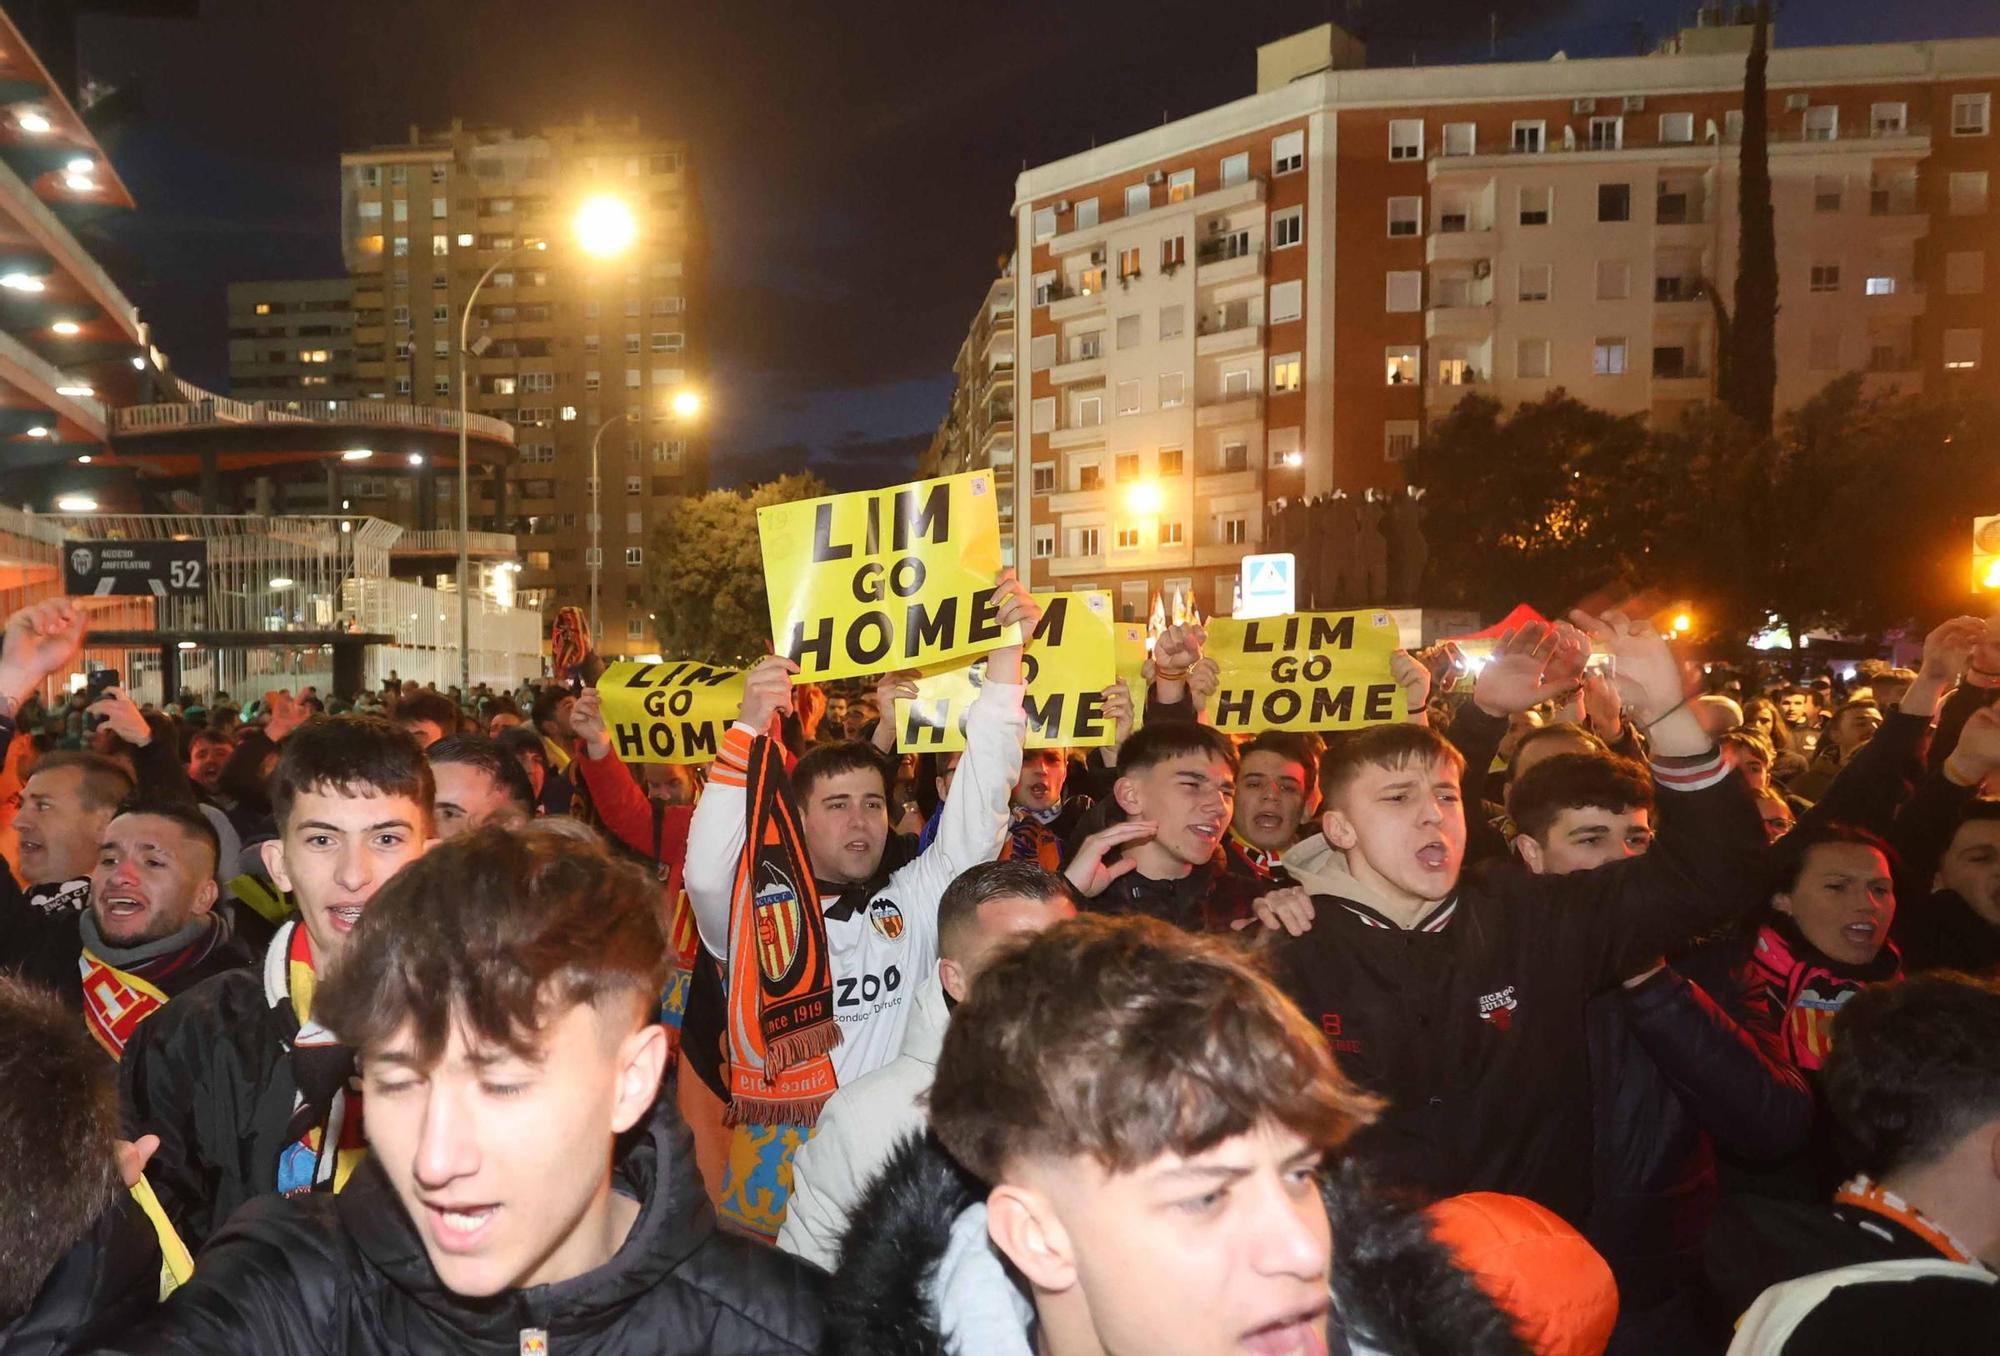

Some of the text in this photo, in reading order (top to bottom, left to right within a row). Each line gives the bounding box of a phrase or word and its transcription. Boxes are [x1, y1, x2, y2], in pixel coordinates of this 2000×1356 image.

[812, 483, 950, 563] LIM
[170, 560, 200, 588] 52
[852, 556, 926, 603] GO
[788, 587, 1001, 674] HOME
[1243, 616, 1355, 652] LIM
[624, 663, 739, 687] LIM
[1271, 654, 1332, 683] GO
[643, 690, 693, 717] GO
[904, 691, 1105, 745] HME
[1215, 684, 1396, 725] HOME
[615, 719, 737, 757] HOM
[837, 965, 900, 1007] ZOO
[794, 1001, 822, 1023] 1919
